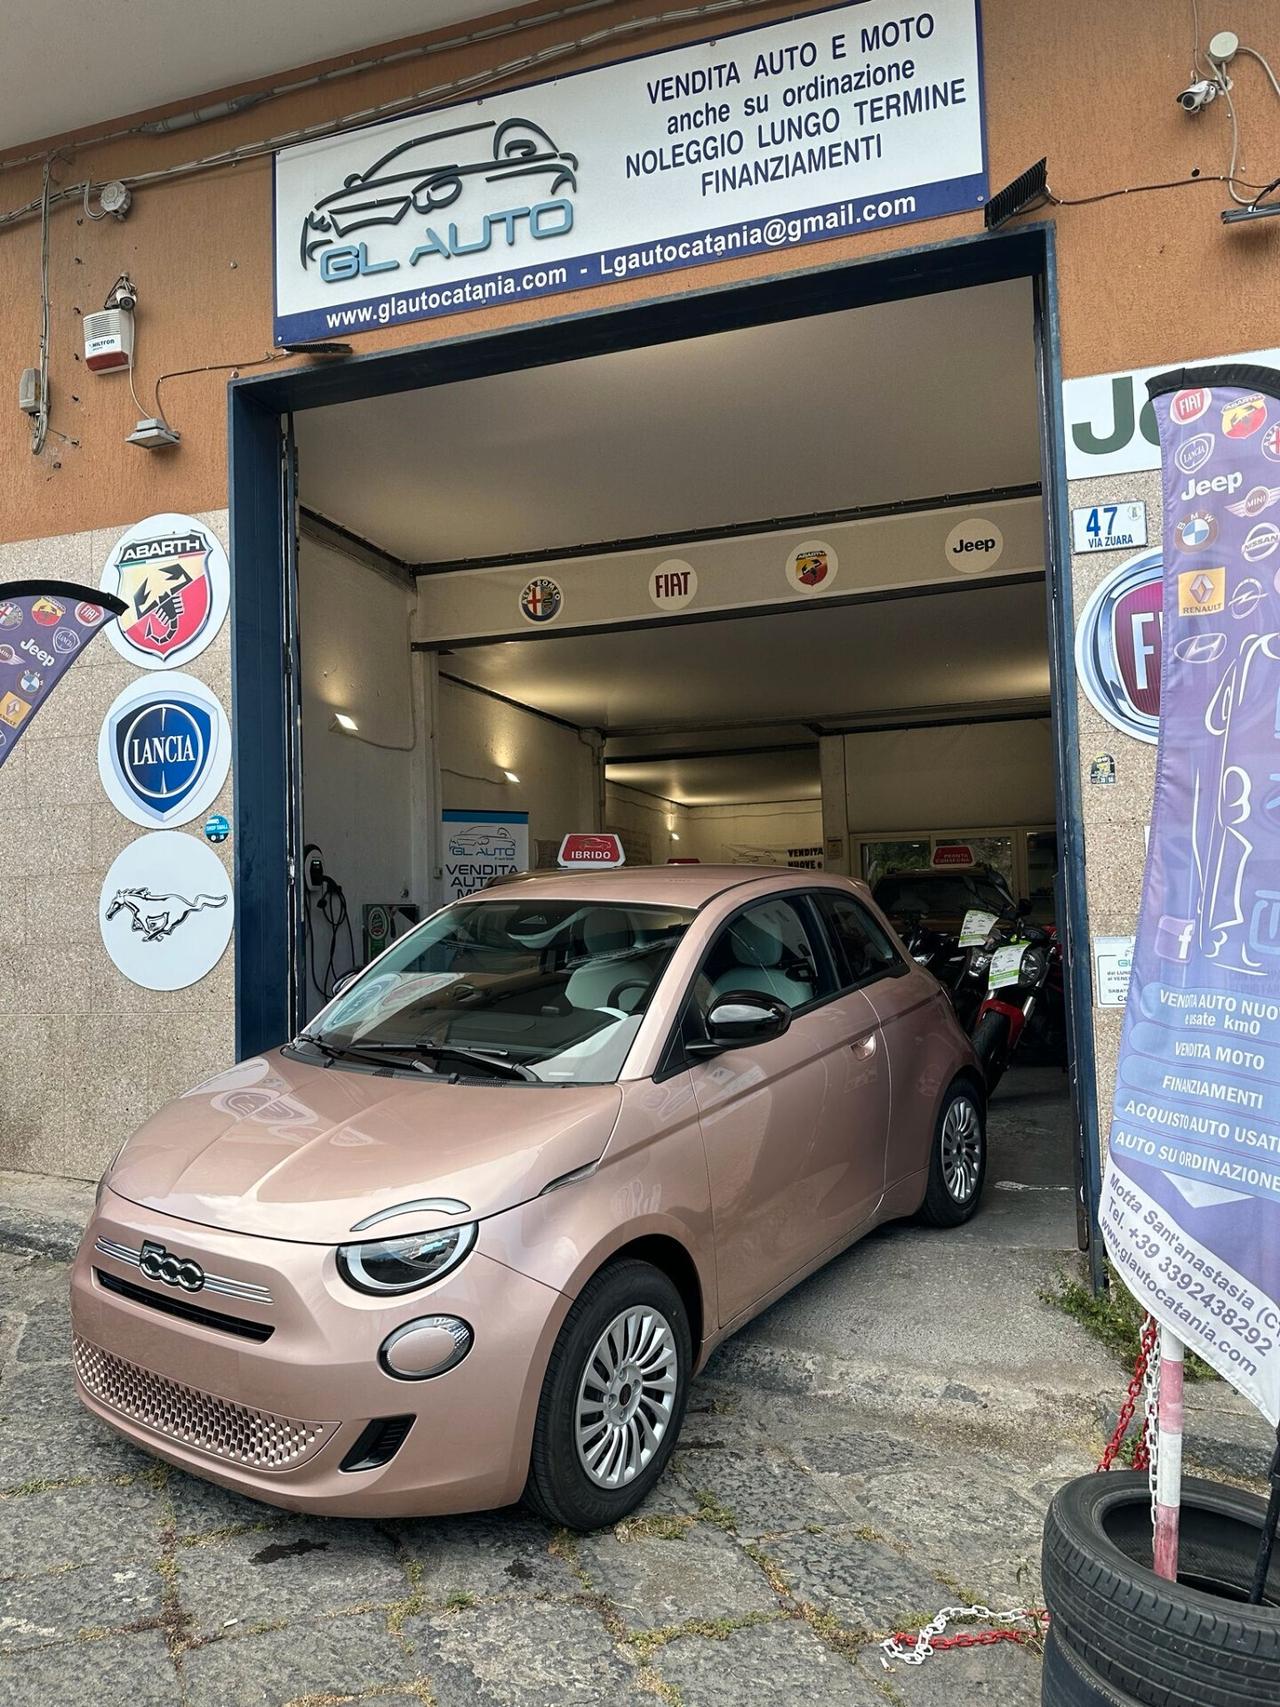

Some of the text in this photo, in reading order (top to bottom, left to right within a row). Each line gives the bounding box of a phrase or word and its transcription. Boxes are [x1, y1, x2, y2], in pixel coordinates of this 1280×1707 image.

[646, 13, 936, 105] VENDITA AUTO E MOTO
[666, 57, 916, 135] anche su ordinazione
[624, 78, 967, 179] NOLEGGIO LUNGO TERMINE
[700, 133, 884, 197] FINANZIAMENTI
[319, 197, 574, 284] GL AUTO
[325, 264, 568, 329] www.glautocatania.com
[599, 192, 917, 275] Lgautocatania@gmail.com
[1179, 393, 1201, 416] FIAT
[1181, 471, 1243, 500] Jeep
[1086, 507, 1118, 537] 47
[1176, 512, 1215, 531] BMW
[124, 539, 200, 561] ABARTH
[953, 536, 996, 555] Jeep
[1088, 534, 1134, 549] VIA ZUARA
[1244, 534, 1279, 550] NISSAN
[655, 571, 691, 598] FIAT
[80, 605, 99, 621] FIAT
[1183, 603, 1222, 614] RENAULT
[20, 638, 55, 667] Jeep
[132, 737, 196, 767] LANCIA
[452, 847, 515, 856] GL AUTO
[571, 851, 611, 860] IBRIDO
[446, 864, 518, 875] VENDITA
[450, 877, 490, 888] AUT
[1160, 989, 1198, 1007] VENDITA
[1198, 993, 1236, 1012] AUTO
[1224, 1015, 1261, 1036] km0
[1175, 1041, 1265, 1070] VENDITA MOTO
[1162, 1075, 1264, 1109] FINANZIAMENTI
[1124, 1100, 1190, 1127] ACQUISTO
[1189, 1118, 1230, 1137] AUTO
[1115, 1130, 1280, 1190] AUTO SU ORDINAZIONE
[1110, 1173, 1143, 1214] Motta
[1144, 1210, 1254, 1310] Sant'anastasia
[140, 1243, 204, 1290] 500
[1106, 1197, 1273, 1356] Tel. +39 3392438292
[1101, 1217, 1257, 1376] www.glautocatania.com
